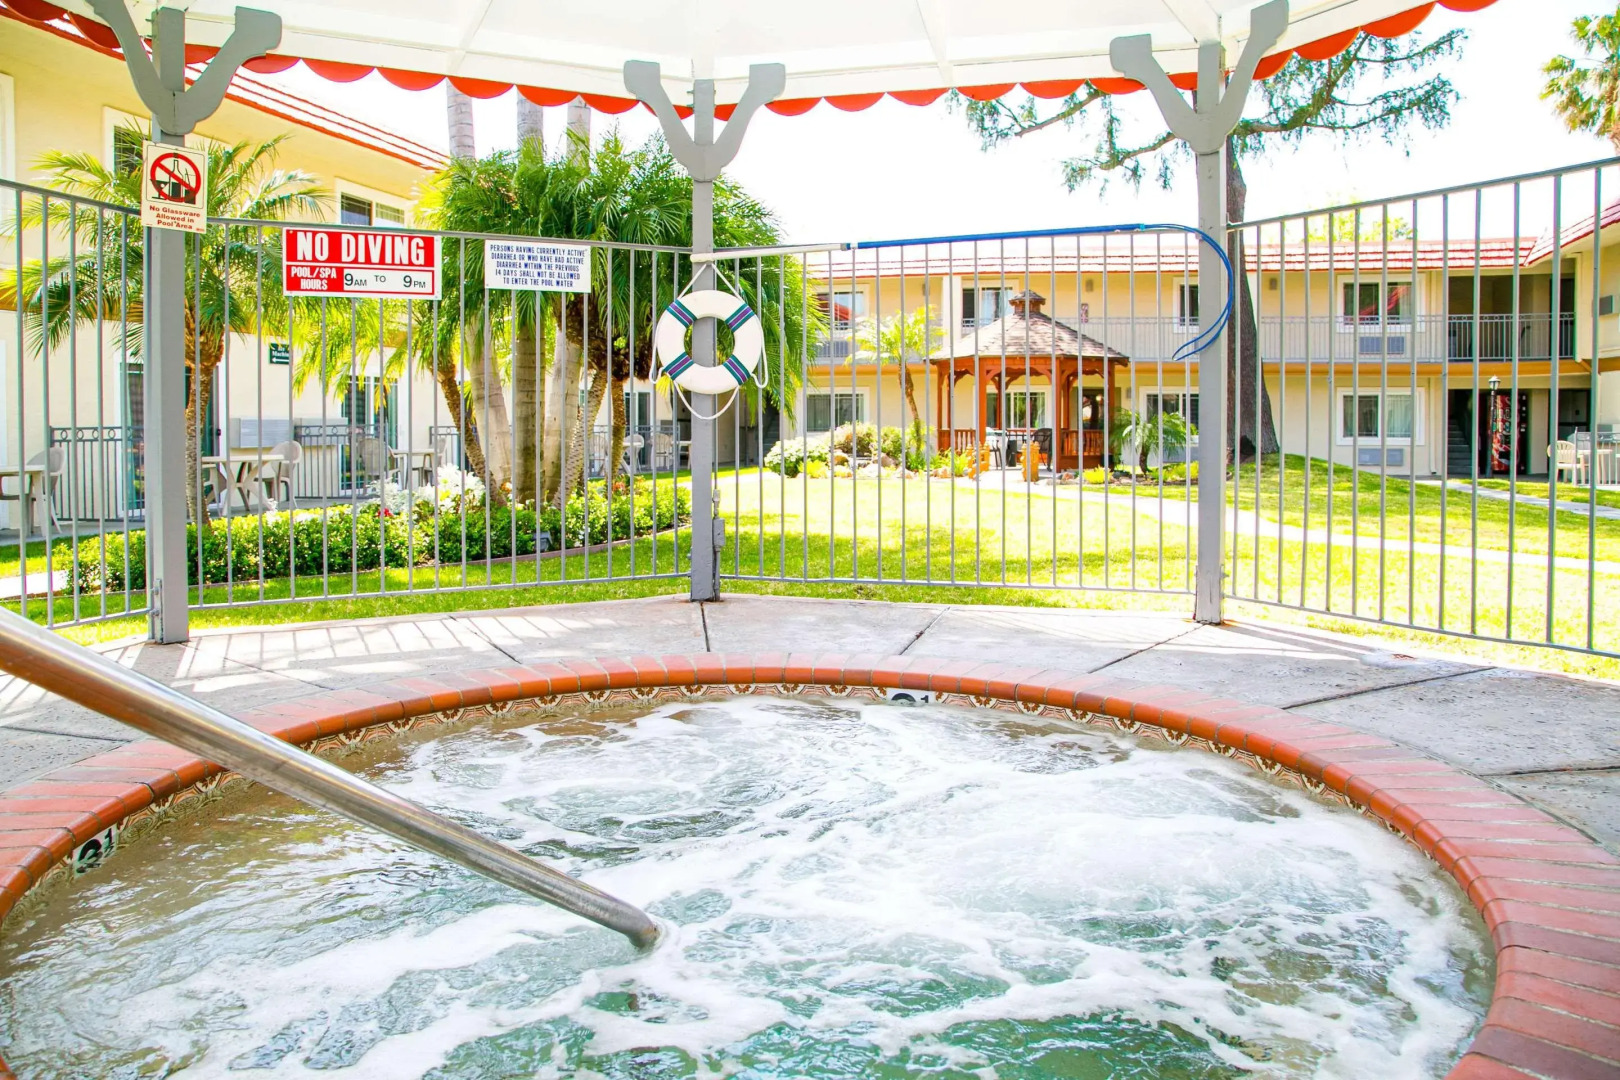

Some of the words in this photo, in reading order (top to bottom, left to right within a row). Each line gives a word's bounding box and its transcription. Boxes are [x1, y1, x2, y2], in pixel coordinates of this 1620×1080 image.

[156, 213, 185, 221] Allowed
[162, 207, 200, 217] Glassware
[296, 232, 329, 261] NO
[341, 233, 425, 265] DIVING
[537, 247, 565, 255] CURRENTLY
[291, 266, 336, 279] POOL/SPA
[374, 275, 386, 283] TO
[300, 279, 328, 290] HOURS
